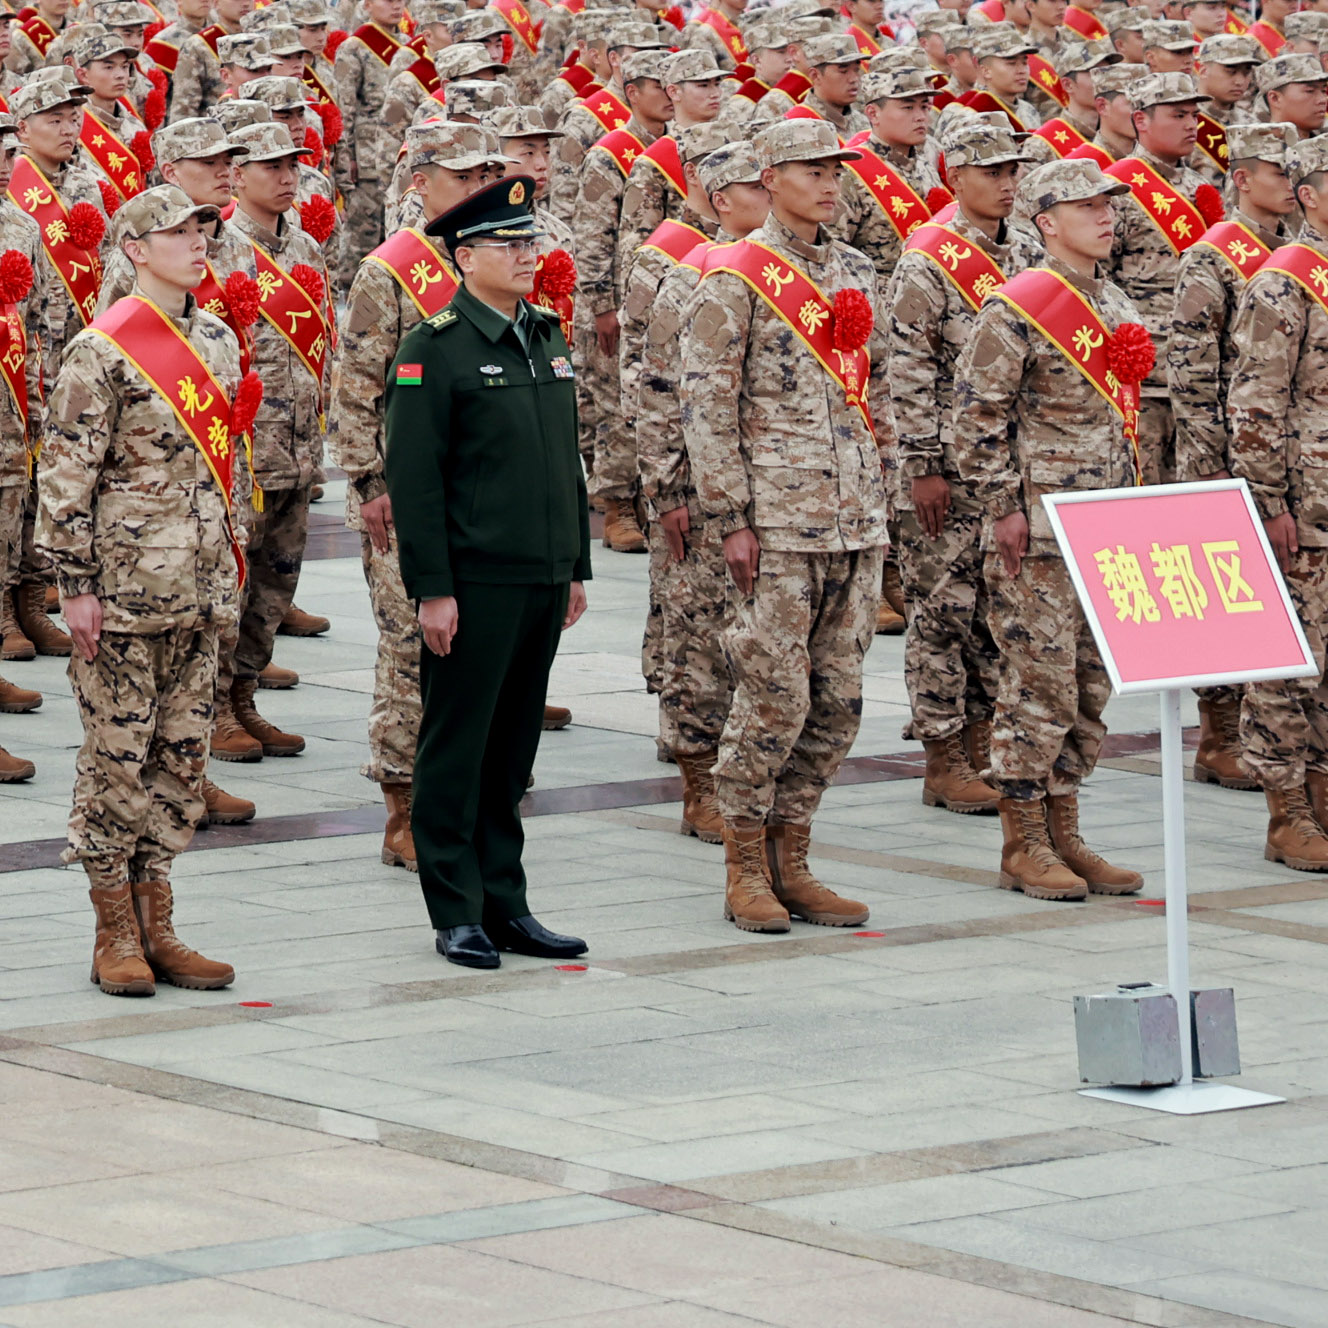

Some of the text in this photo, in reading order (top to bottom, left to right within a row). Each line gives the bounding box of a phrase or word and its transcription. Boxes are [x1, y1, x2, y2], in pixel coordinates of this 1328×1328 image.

[107, 152, 140, 193] 参军
[1152, 191, 1193, 241] 参军
[1232, 238, 1261, 266] 光
[410, 259, 443, 296] 光
[1092, 540, 1264, 625] 魏都区
